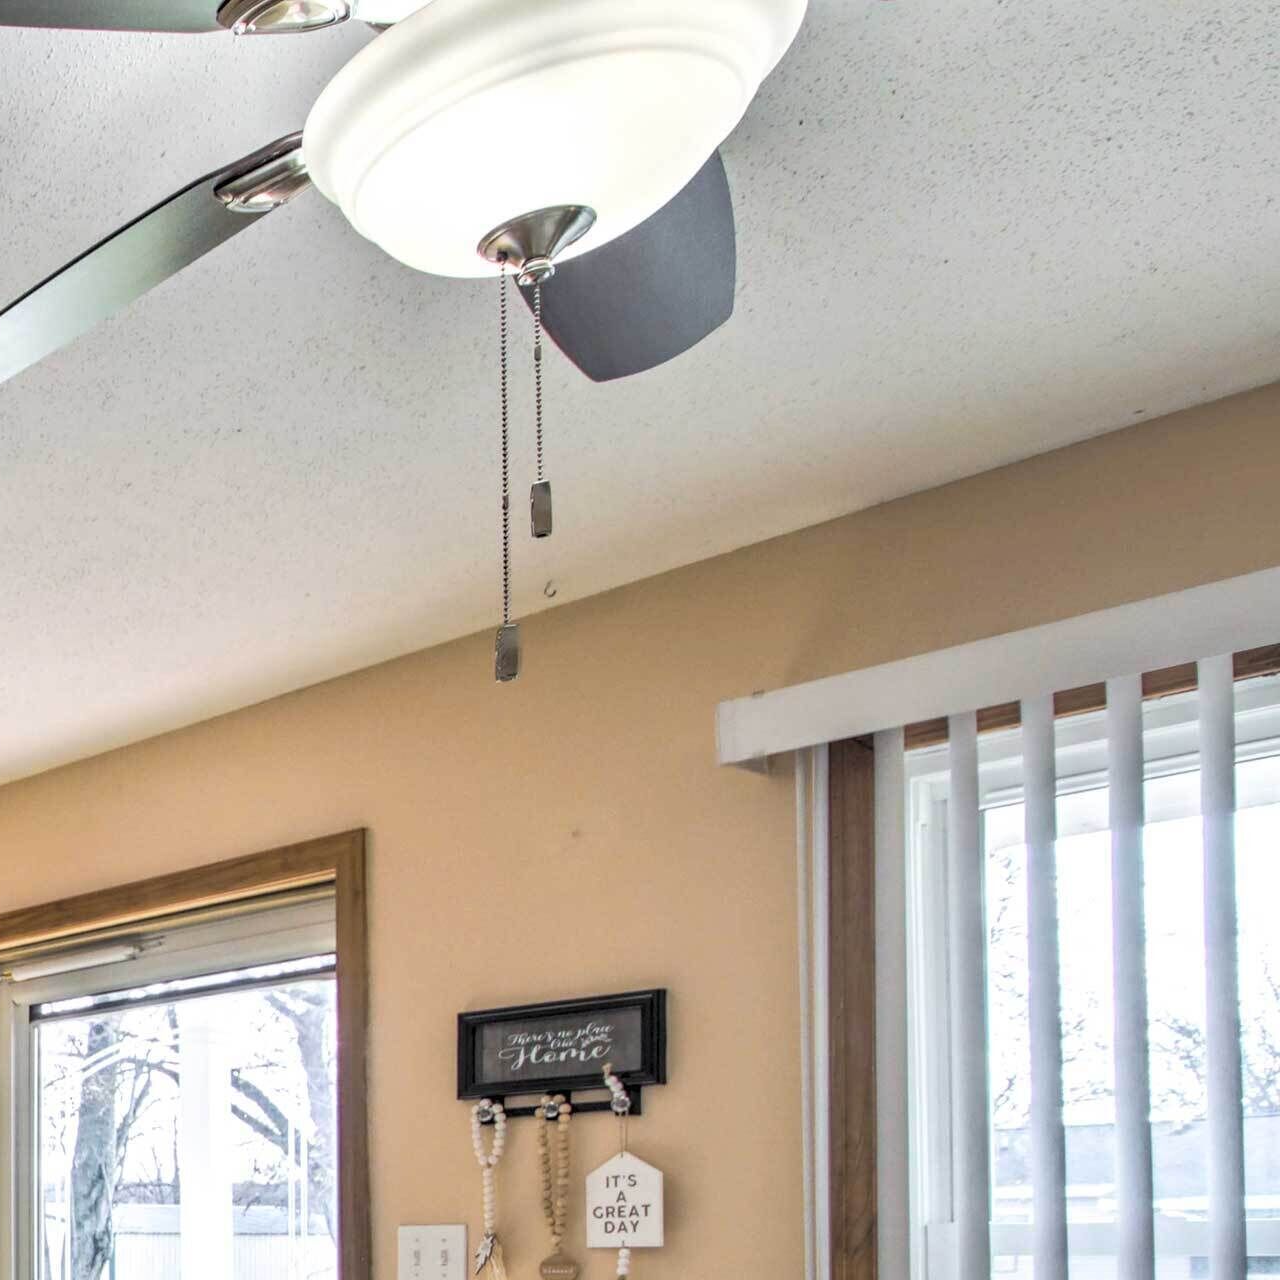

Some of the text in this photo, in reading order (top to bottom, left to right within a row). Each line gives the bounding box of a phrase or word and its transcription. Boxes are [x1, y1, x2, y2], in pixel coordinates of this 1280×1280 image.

[507, 1022, 615, 1045] There's no place
[498, 1044, 611, 1071] Home
[605, 1174, 637, 1188] IT'S
[616, 1190, 627, 1203] A
[592, 1204, 651, 1219] GREAT
[604, 1220, 640, 1234] DAY
